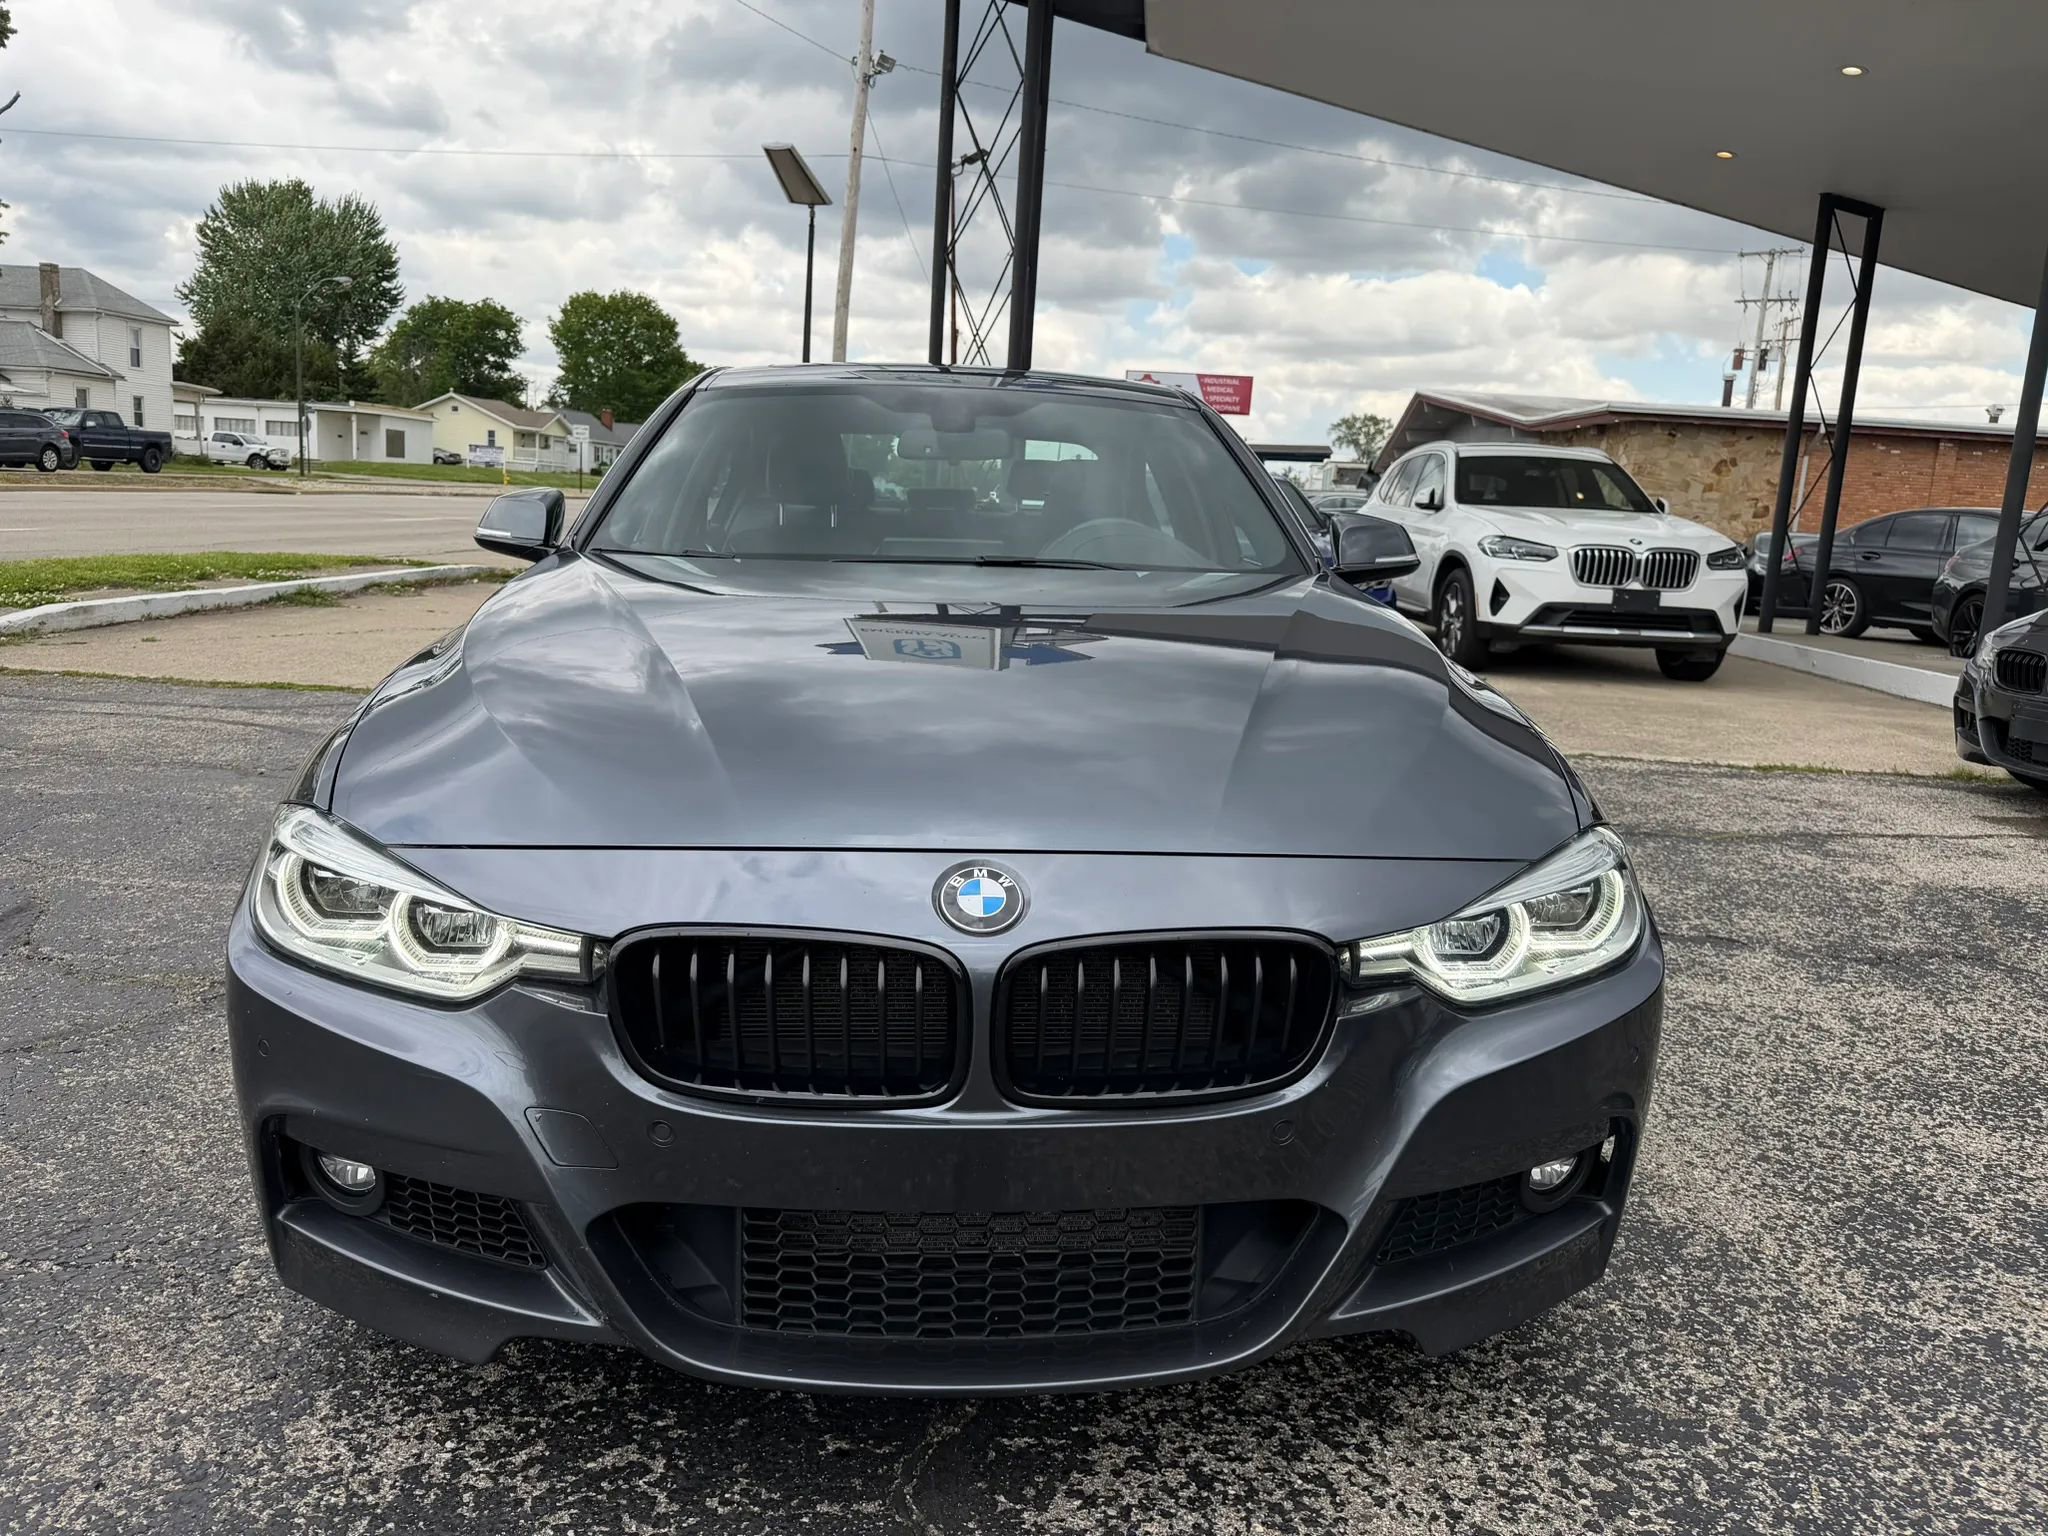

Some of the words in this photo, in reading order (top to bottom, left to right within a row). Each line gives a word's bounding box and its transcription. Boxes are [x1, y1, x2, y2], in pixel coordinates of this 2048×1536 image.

[1204, 378, 1240, 386] INDUSTRIAL
[1207, 386, 1234, 394] MEDICAL
[1209, 394, 1240, 403] SPECIALTY
[949, 869, 1014, 888] BMW
